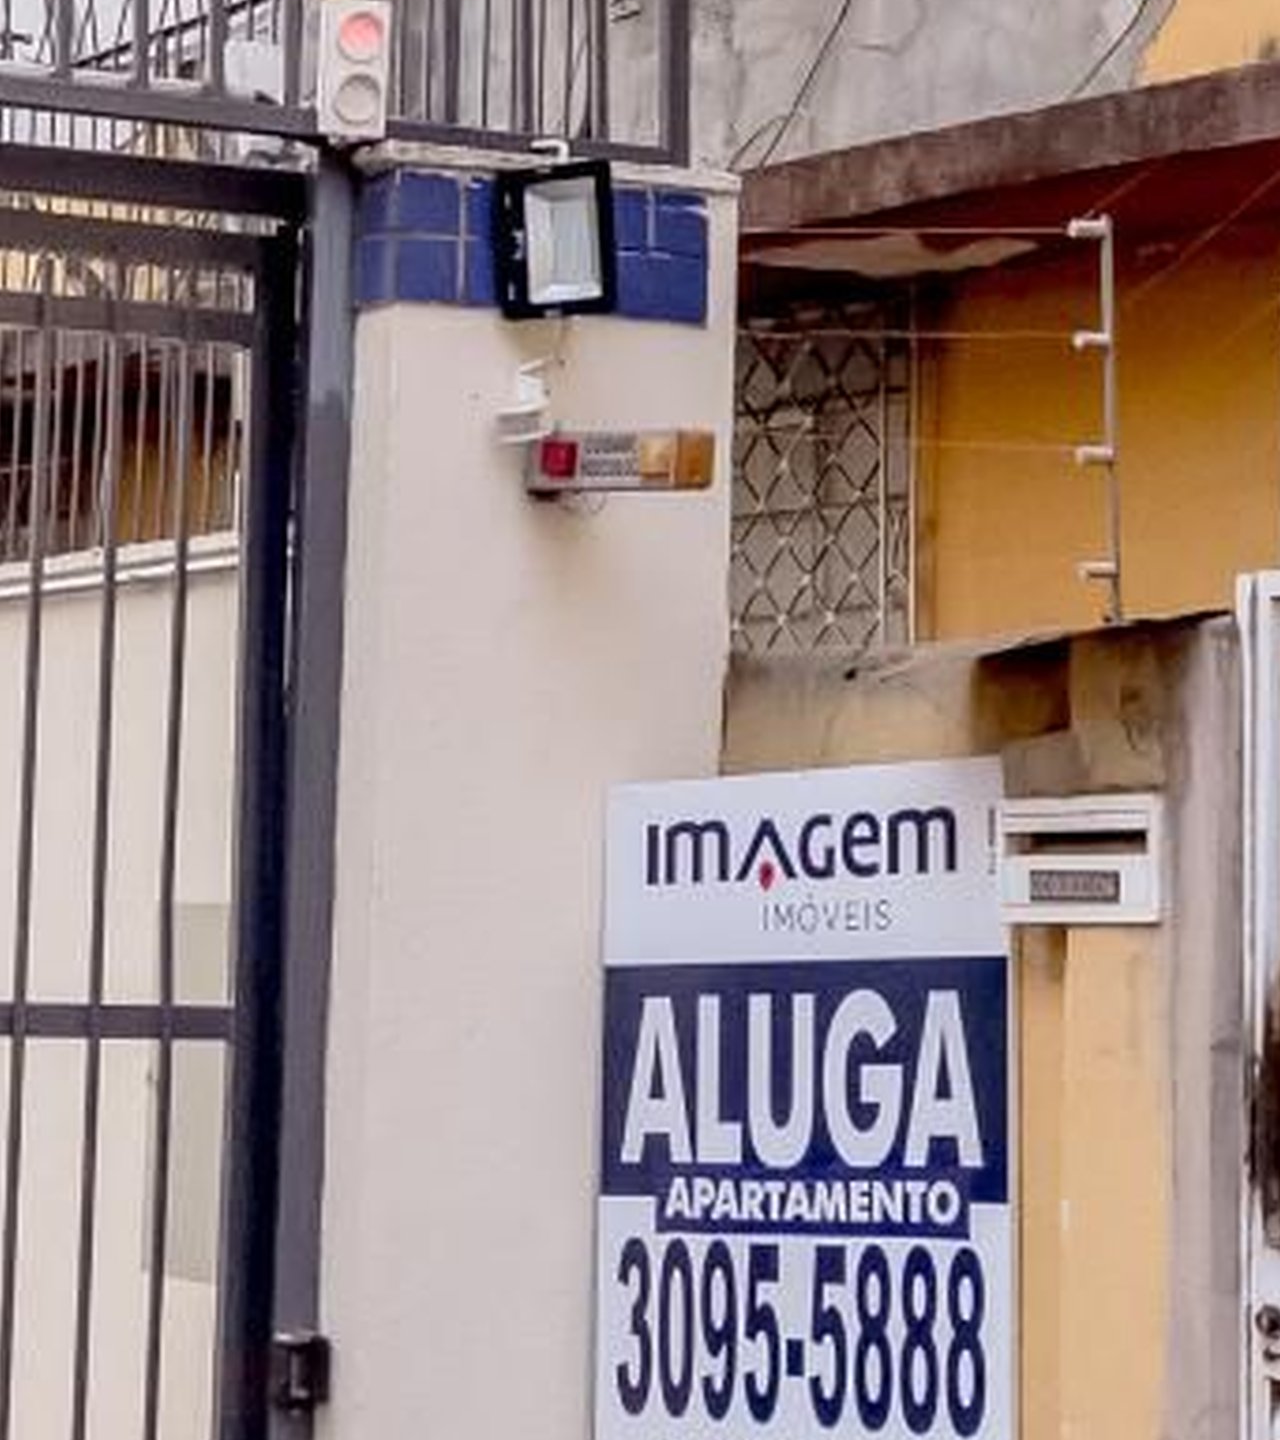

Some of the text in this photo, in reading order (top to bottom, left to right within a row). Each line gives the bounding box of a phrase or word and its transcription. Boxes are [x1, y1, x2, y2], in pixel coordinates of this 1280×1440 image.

[762, 893, 894, 935] IMÓVEIS
[620, 988, 984, 1169] ALUGA
[664, 1176, 960, 1225] APARTAMENTO
[616, 1237, 986, 1437] 3095-5888
